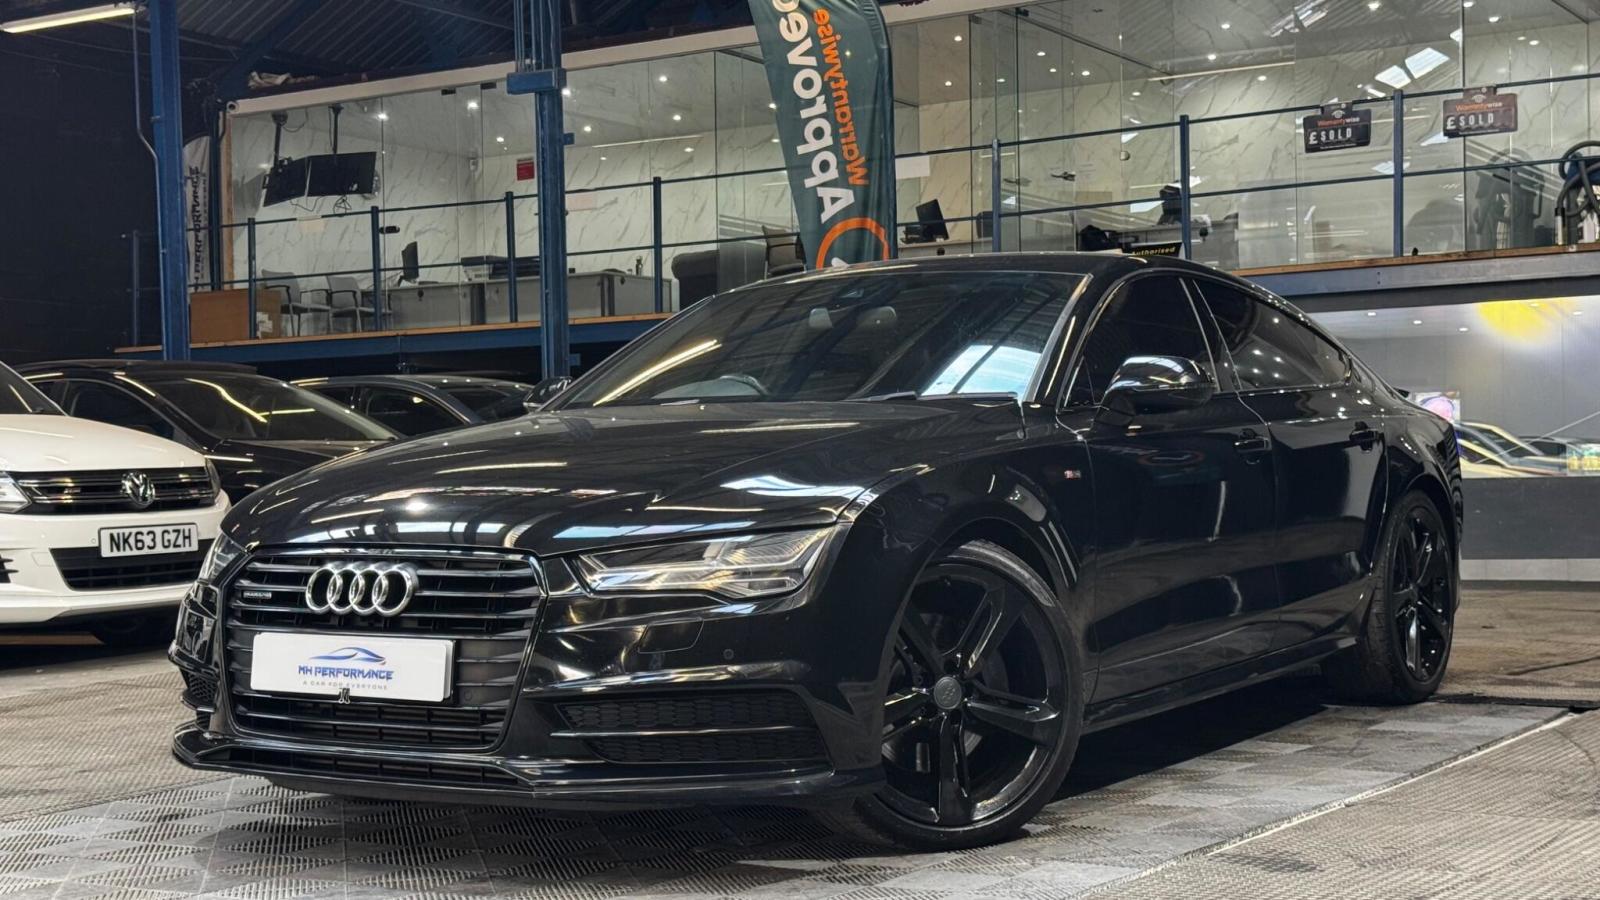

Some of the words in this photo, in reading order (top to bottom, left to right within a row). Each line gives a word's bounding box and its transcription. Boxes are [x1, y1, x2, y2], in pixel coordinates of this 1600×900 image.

[109, 530, 157, 553] NK63
[161, 528, 192, 549] GZH
[298, 665, 313, 675] MH
[314, 667, 395, 681] PERFORMANCE
